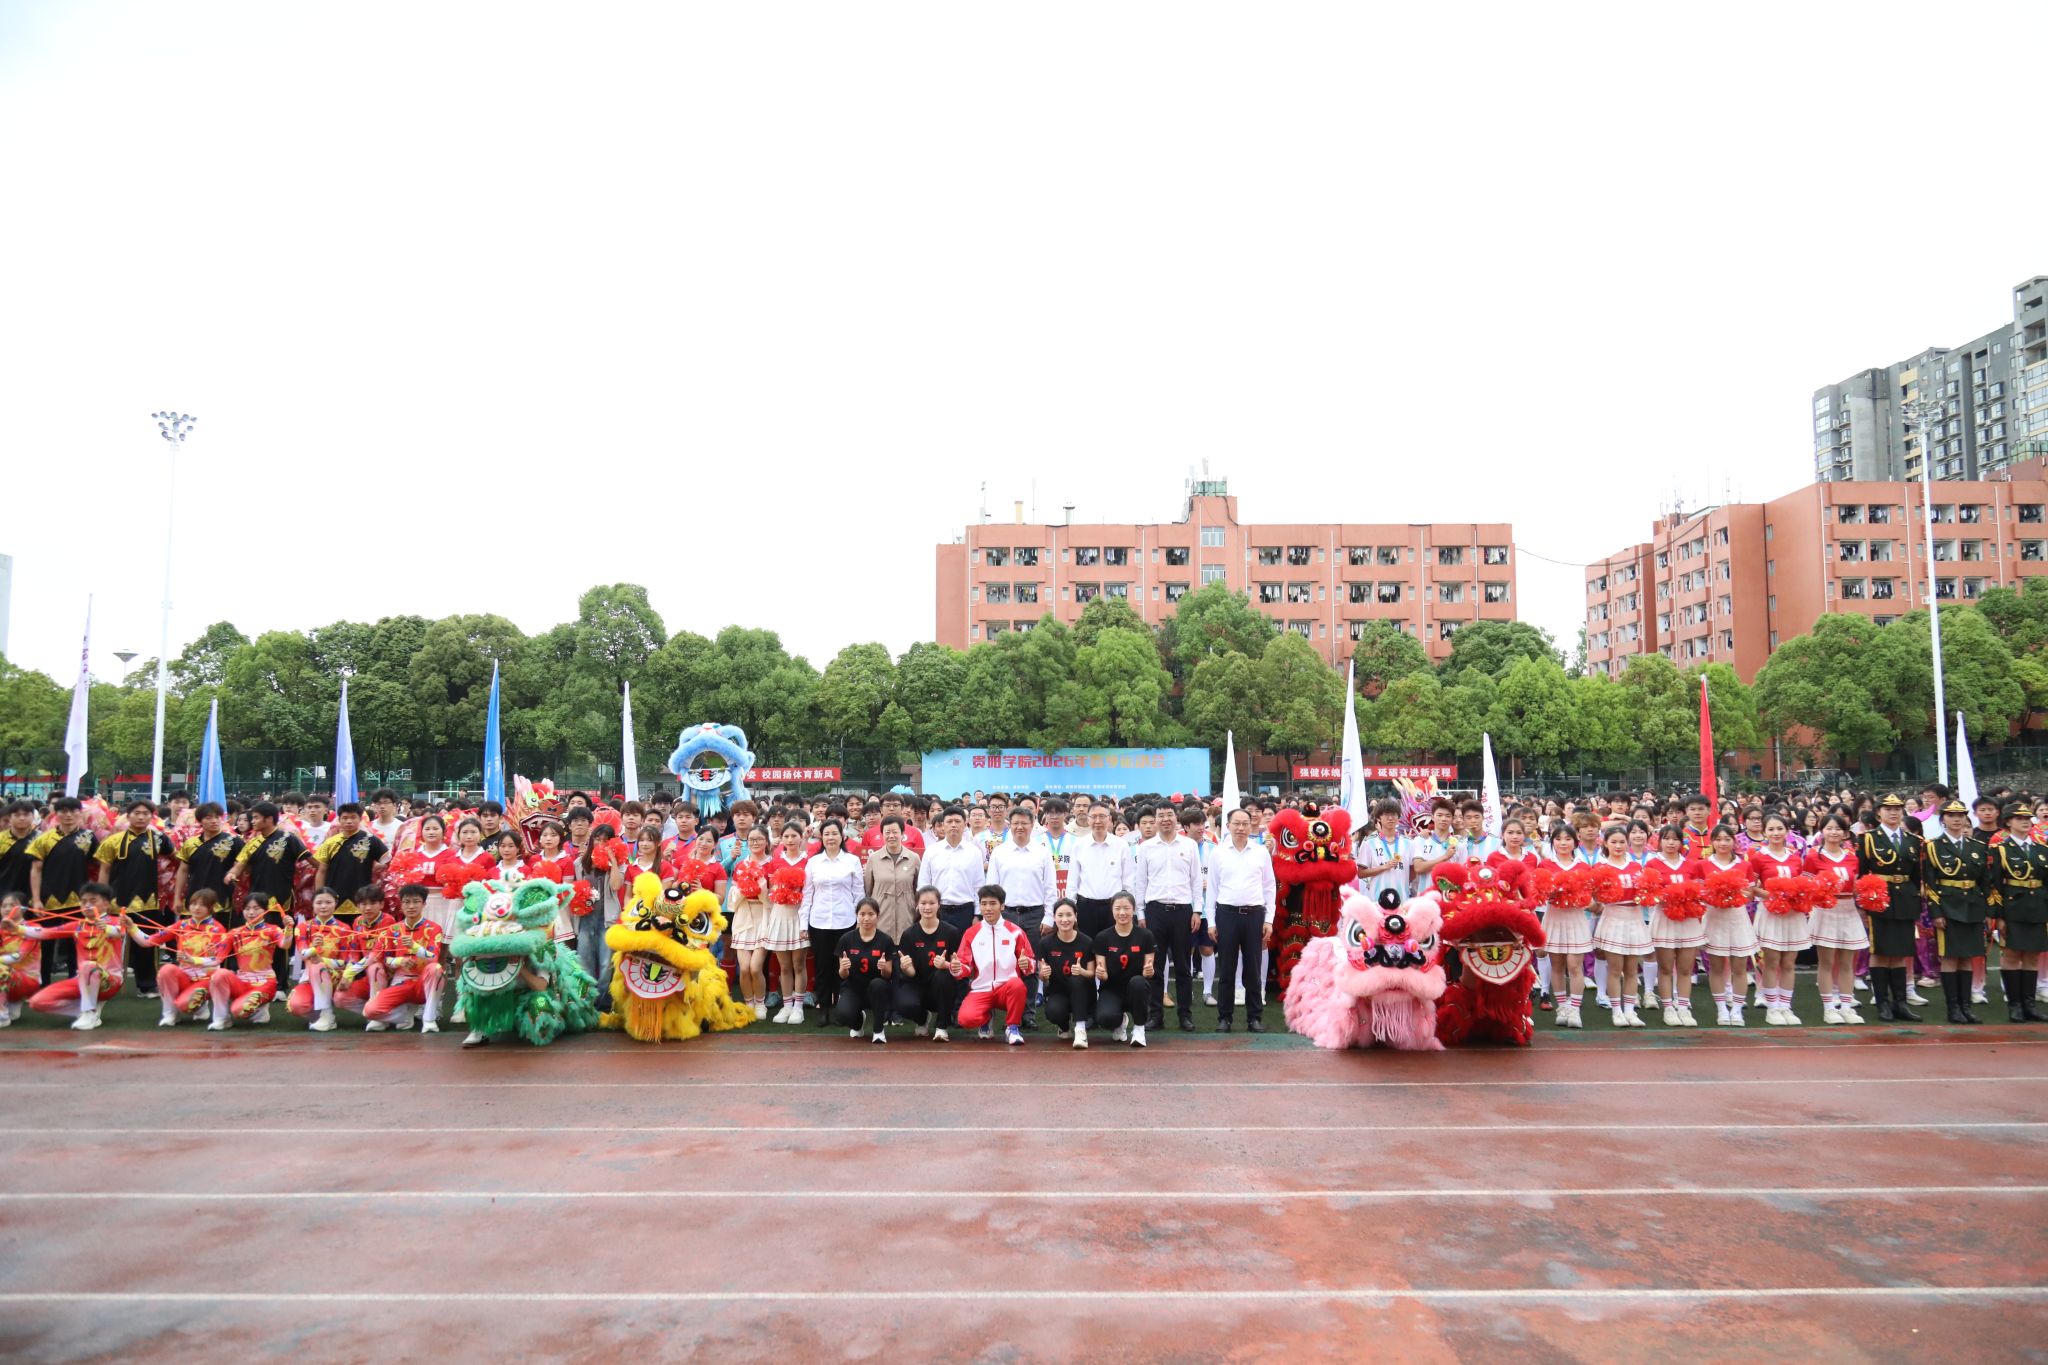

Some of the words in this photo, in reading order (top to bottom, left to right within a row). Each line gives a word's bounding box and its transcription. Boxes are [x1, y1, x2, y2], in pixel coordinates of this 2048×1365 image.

[761, 770, 834, 779] 校园扬体育新风
[860, 958, 869, 974] 3
[1062, 960, 1071, 975] 6
[1120, 954, 1128, 969] 9
